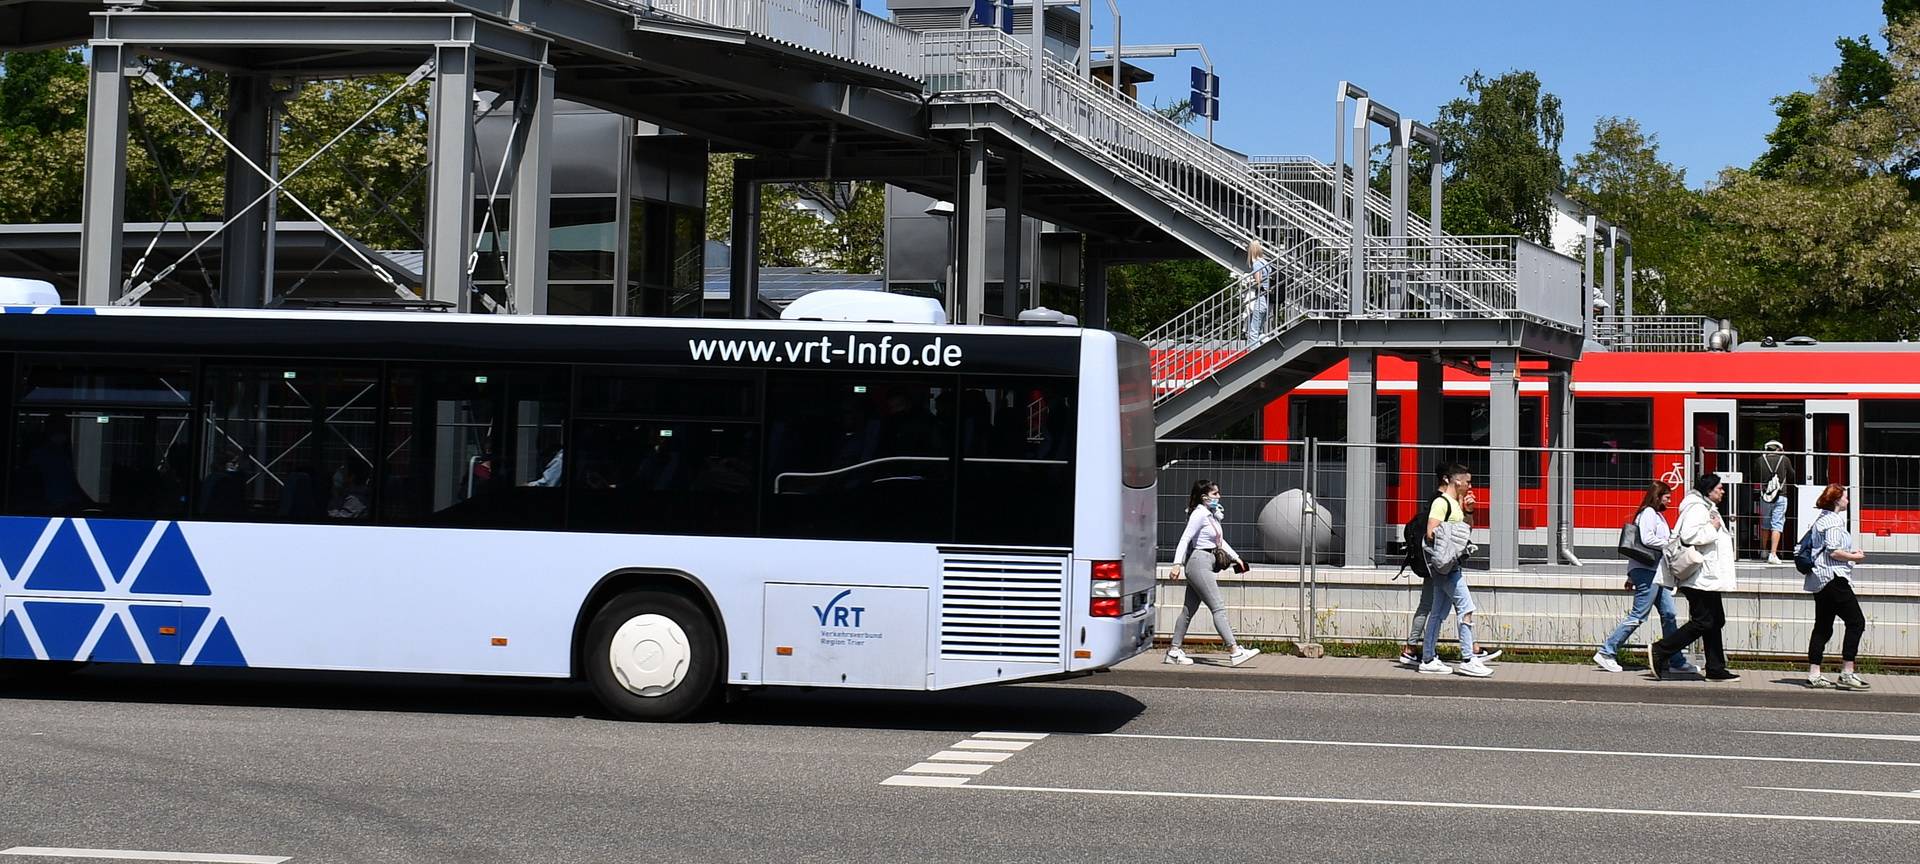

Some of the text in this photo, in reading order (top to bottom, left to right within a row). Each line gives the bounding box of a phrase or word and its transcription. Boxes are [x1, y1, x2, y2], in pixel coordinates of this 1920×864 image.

[688, 335, 963, 366] www.vrt-Info.de
[812, 589, 865, 627] VRT
[820, 630, 883, 639] Verkehrsverbund
[820, 638, 865, 646] Region Trier
